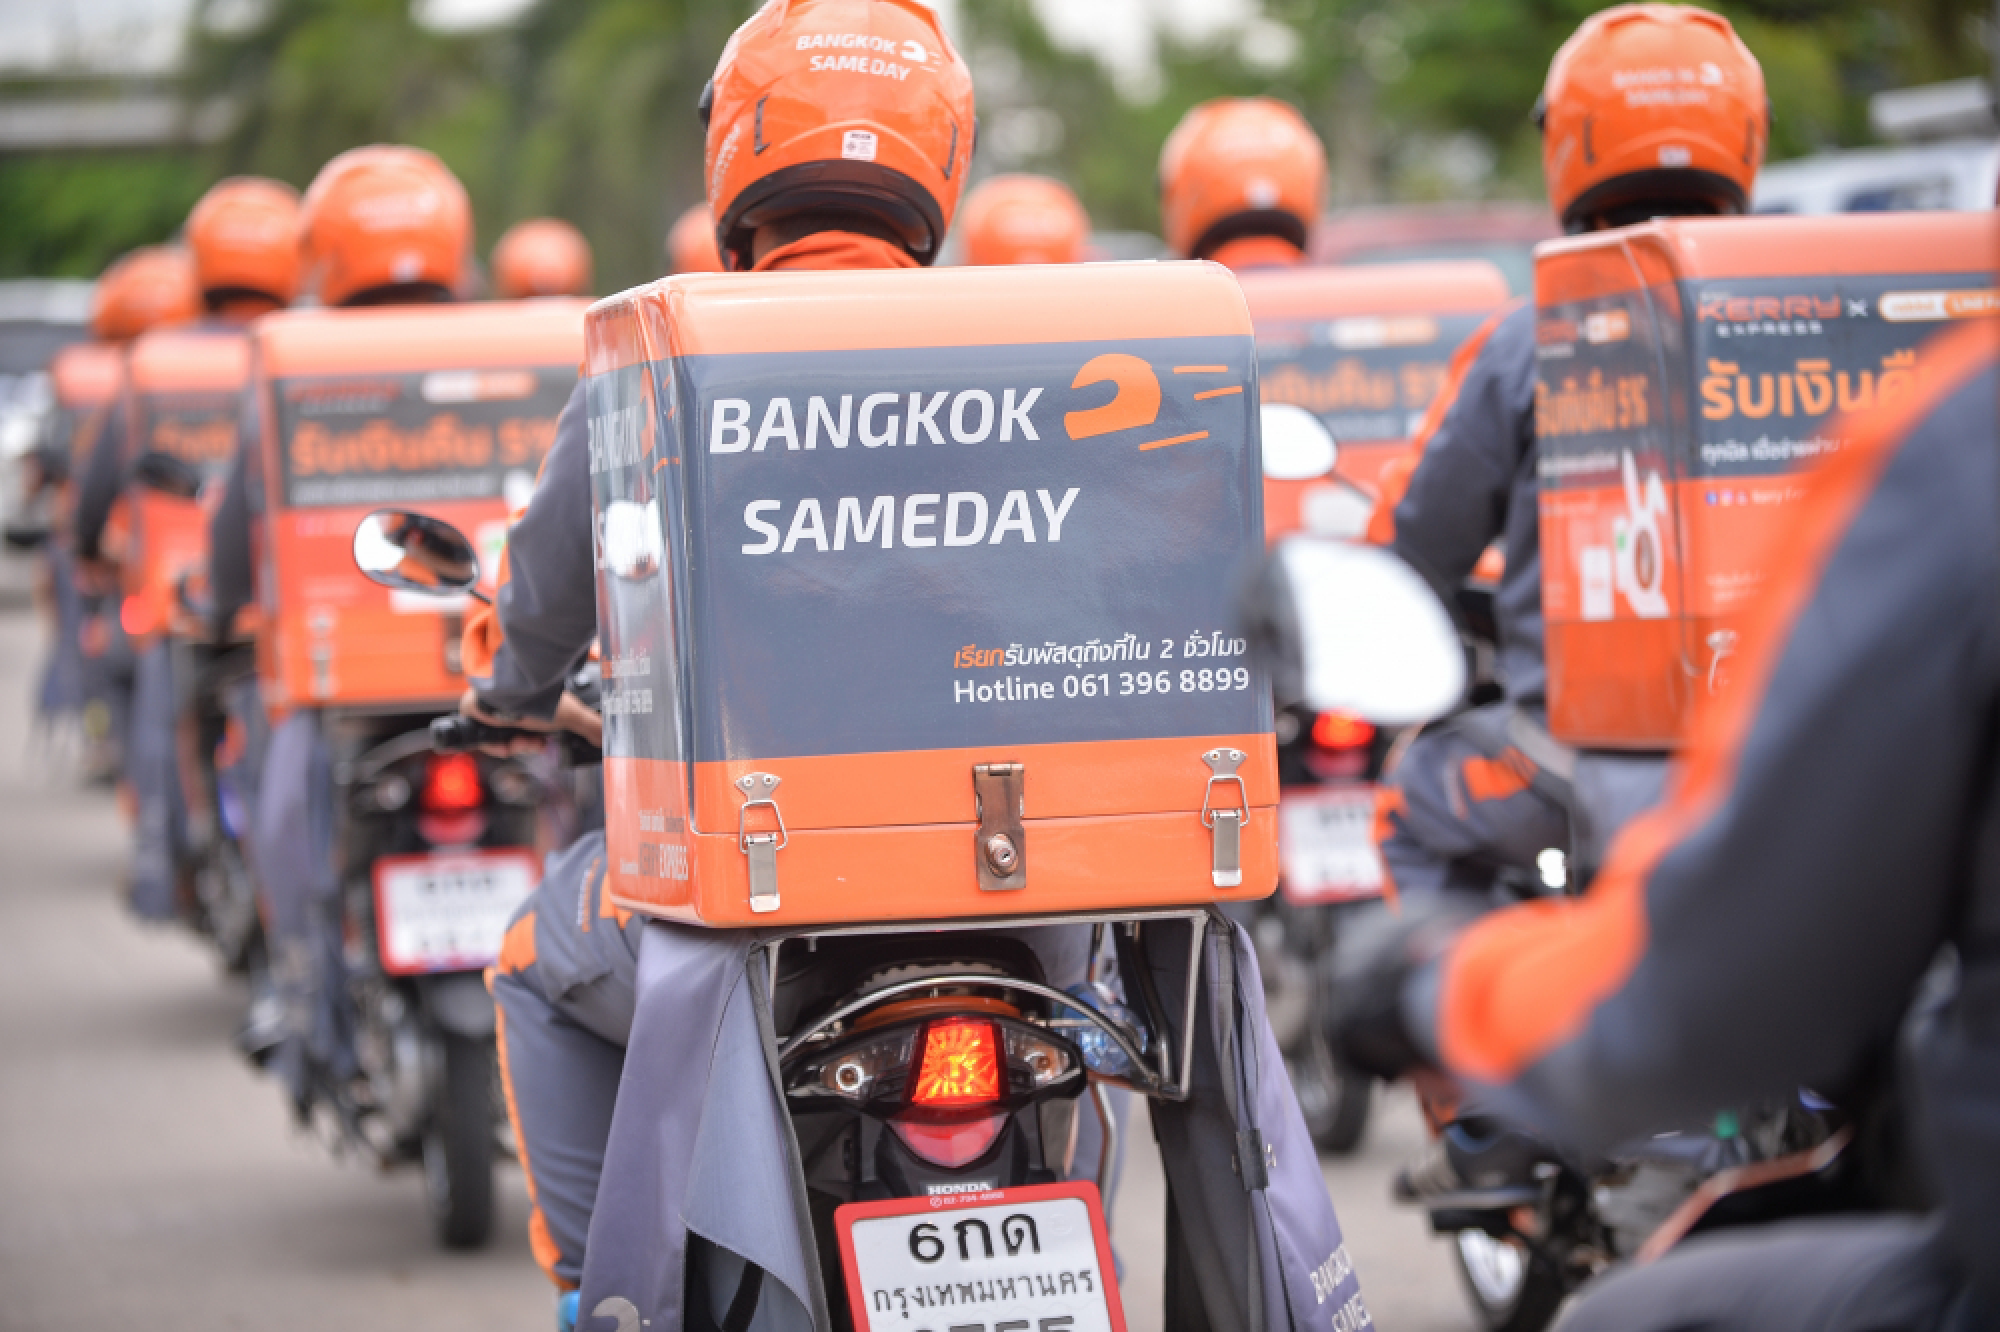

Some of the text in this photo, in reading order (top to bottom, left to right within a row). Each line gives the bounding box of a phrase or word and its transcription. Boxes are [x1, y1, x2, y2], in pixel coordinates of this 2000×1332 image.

[795, 34, 897, 55] BANGKOK
[809, 55, 912, 82] SAMEDAY
[1696, 295, 1841, 322] KERRY
[1700, 348, 1917, 420] รับเงินคื
[709, 387, 1044, 454] BANGKOK
[741, 487, 1080, 556] SAMEDAY
[1159, 639, 1174, 659] 2
[953, 667, 1250, 704] Hotline 061 396 8899
[927, 1182, 992, 1196] HONDA
[909, 1213, 1041, 1264] 6กด
[873, 1269, 1094, 1319] กรุงเทพมหานคร
